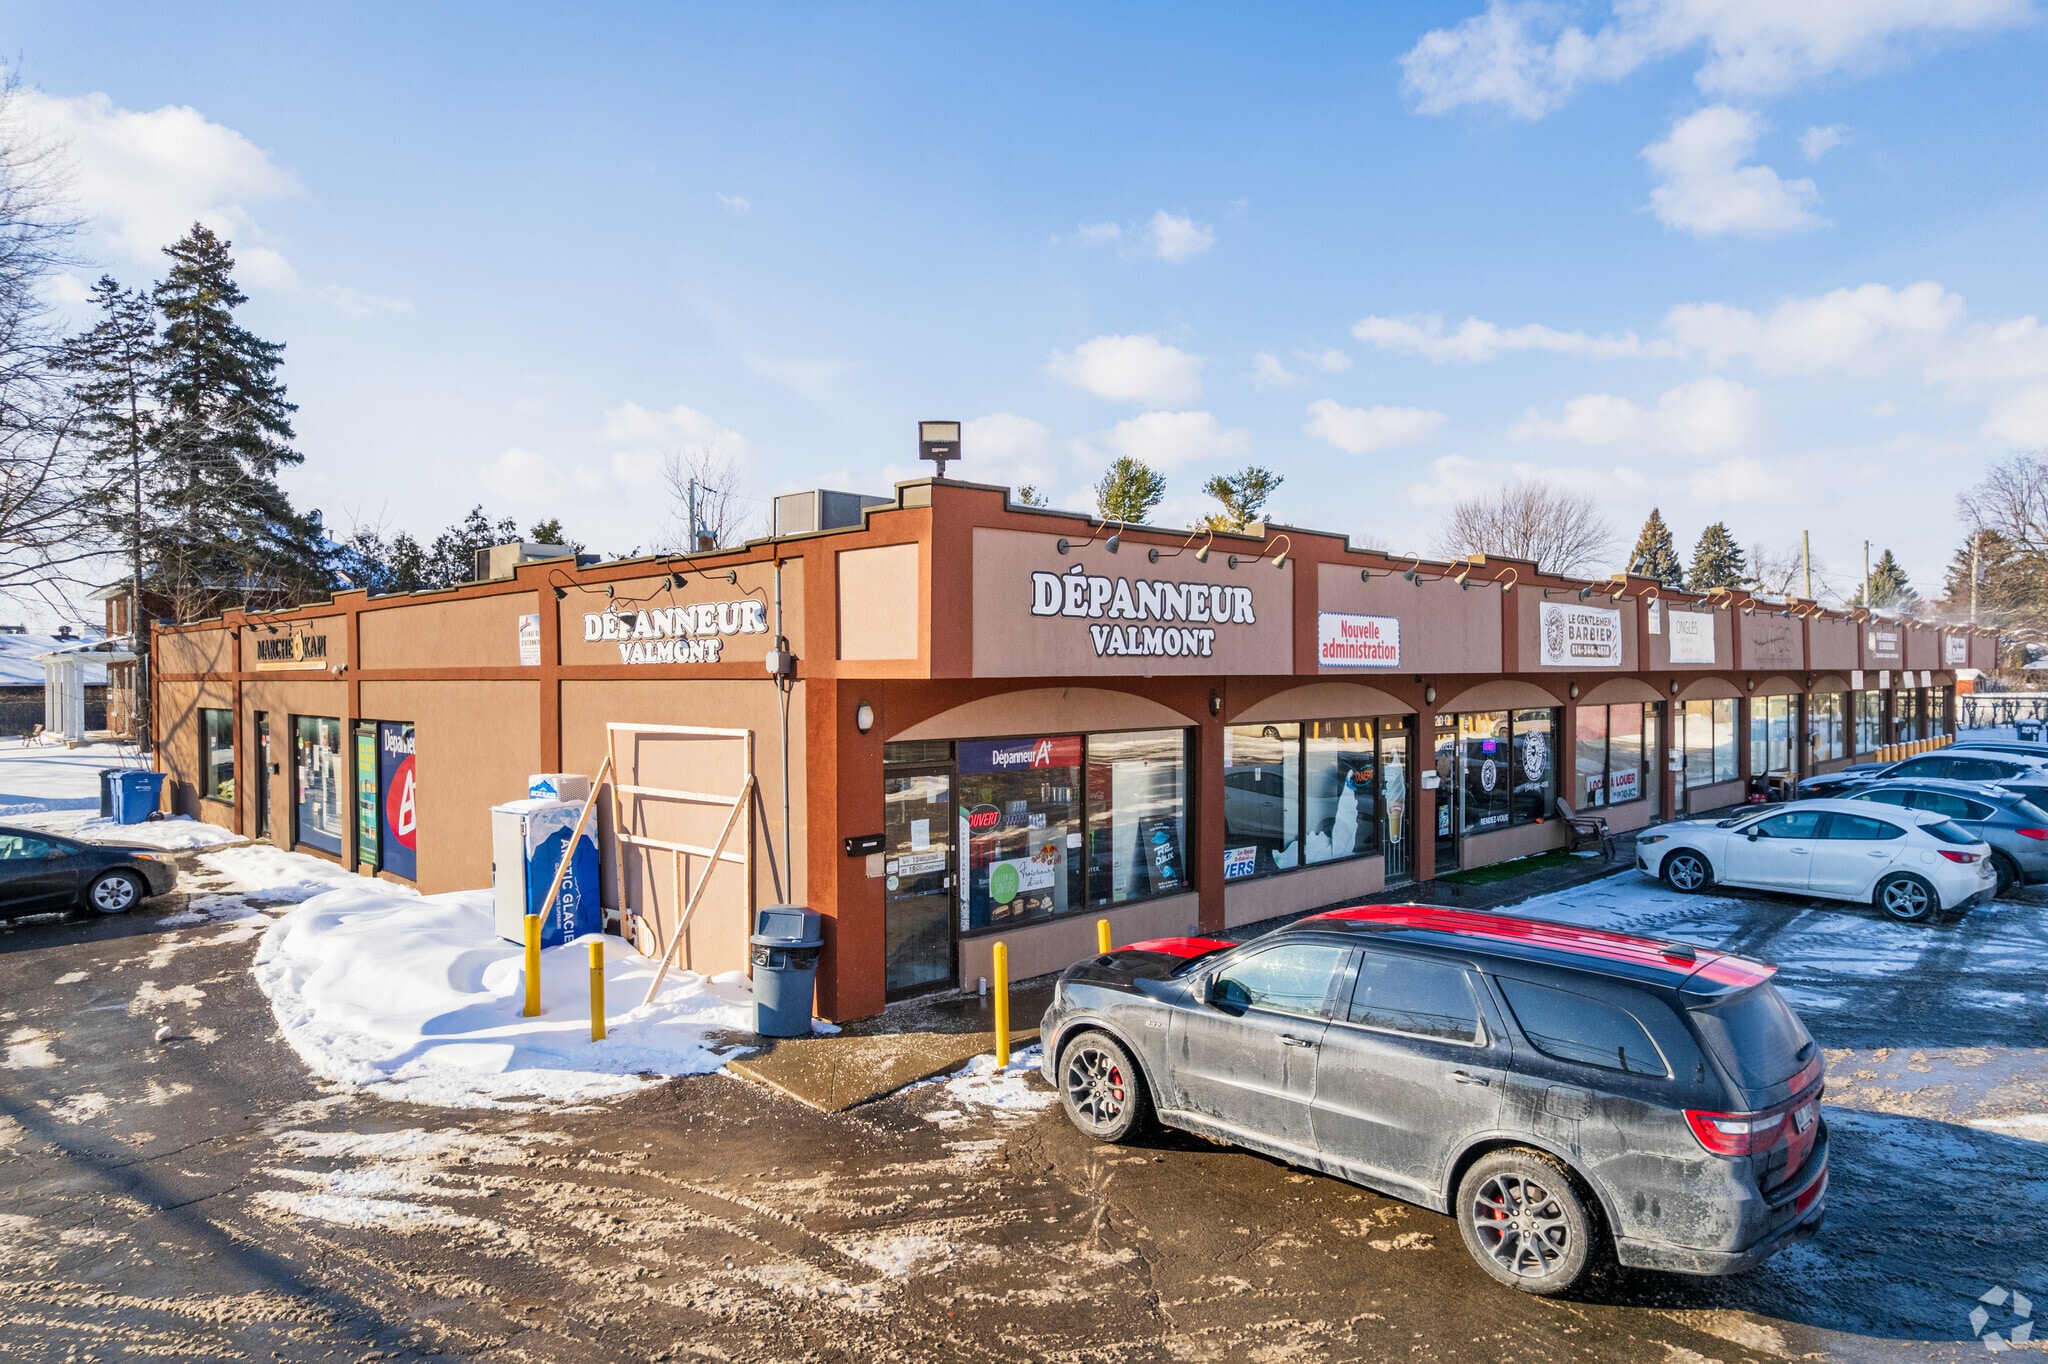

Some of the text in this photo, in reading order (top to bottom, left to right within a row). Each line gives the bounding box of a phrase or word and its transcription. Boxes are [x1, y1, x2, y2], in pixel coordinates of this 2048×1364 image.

[1031, 564, 1256, 625] DÉPANNEUR
[1340, 620, 1380, 639] Nouvelle
[1568, 614, 1612, 627] LE GENTLEMEN
[1676, 620, 1698, 635] ONGLES
[1089, 624, 1215, 658] VALMONT
[1568, 626, 1612, 641] BARBIER
[257, 632, 293, 660] MARCHÉ
[617, 637, 723, 665] VALMONT
[1322, 638, 1397, 661] administration
[992, 740, 1053, 768] Dépanneur A+
[1615, 773, 1635, 786] LOUER
[968, 812, 999, 827] OUVERT
[1480, 814, 1509, 826] RENDEZ-VOUS
[562, 893, 575, 943] GLACIE
